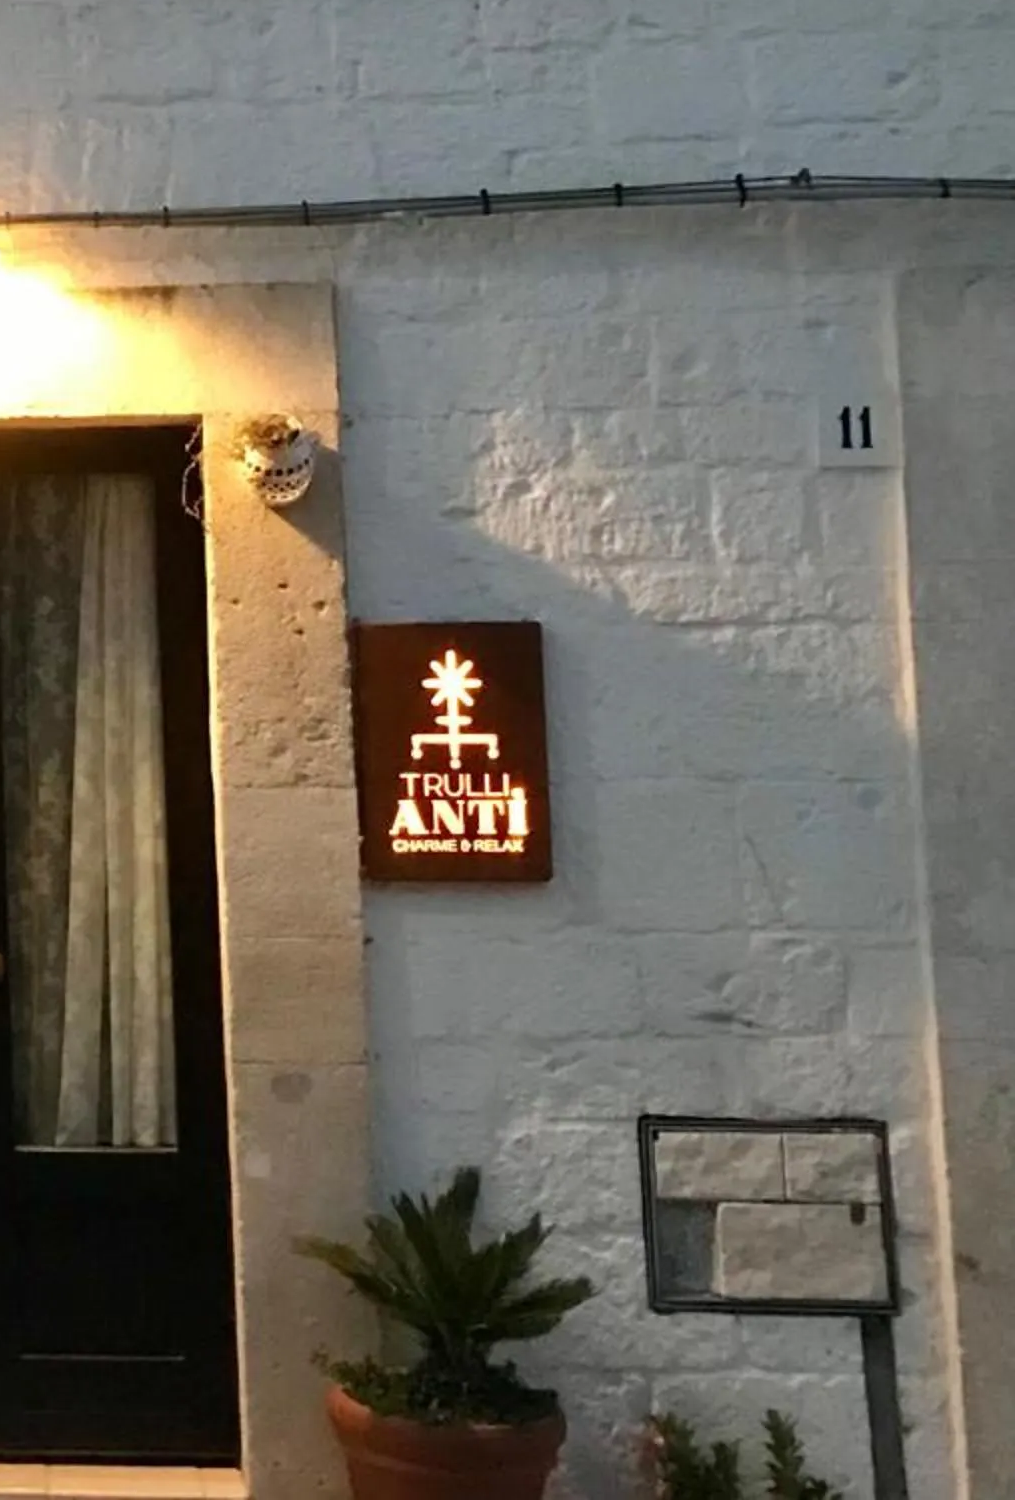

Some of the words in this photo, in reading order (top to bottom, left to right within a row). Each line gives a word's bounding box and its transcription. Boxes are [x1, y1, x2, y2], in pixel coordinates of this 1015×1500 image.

[838, 406, 874, 449] 11
[399, 772, 510, 797] TRULLI
[392, 838, 458, 853] CHARME
[473, 838, 524, 853] RELAX
